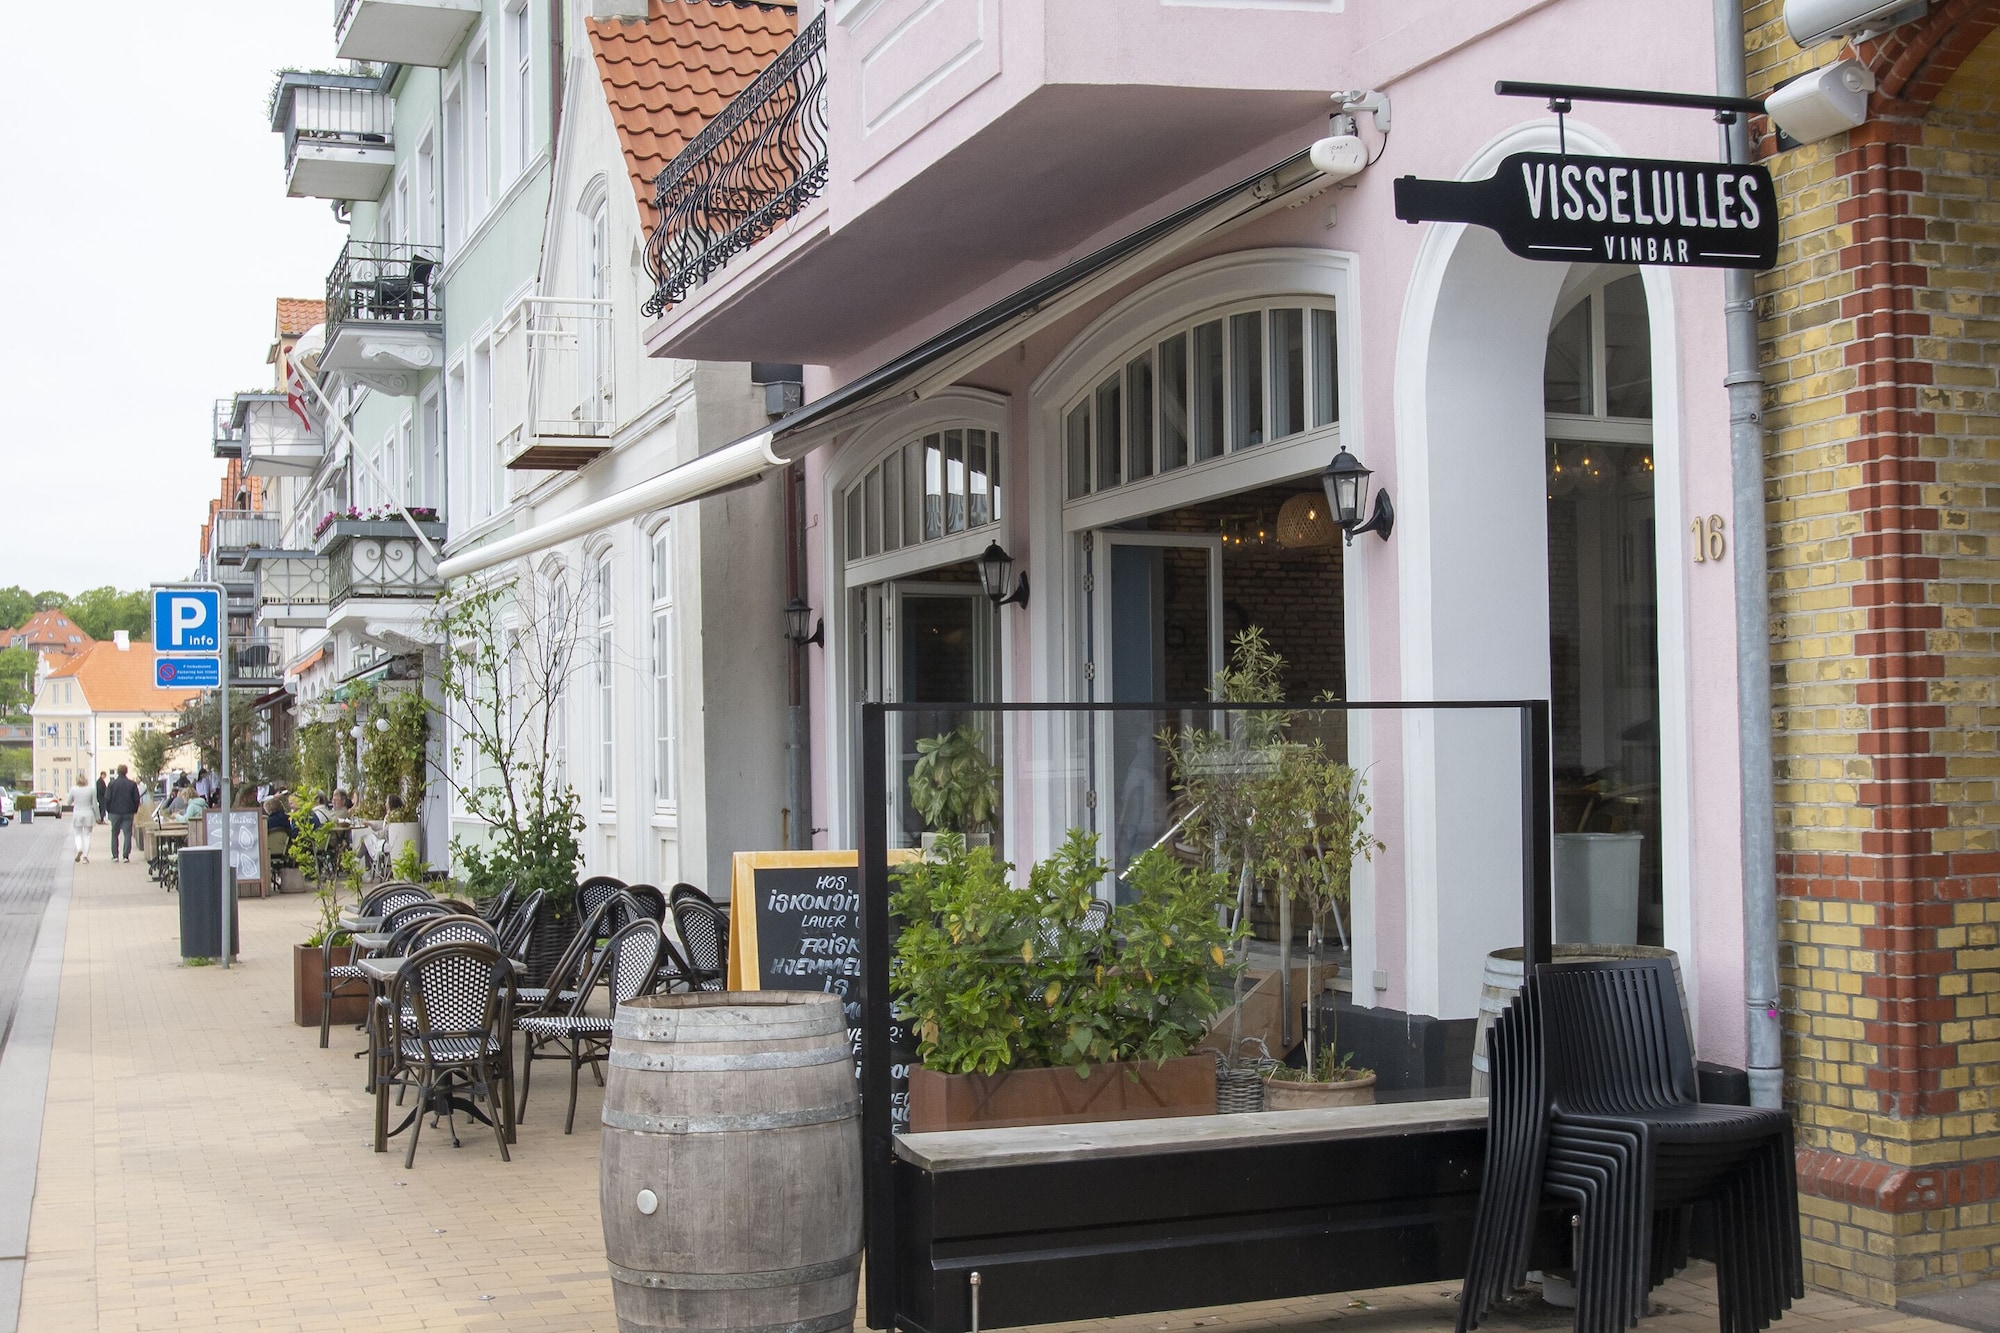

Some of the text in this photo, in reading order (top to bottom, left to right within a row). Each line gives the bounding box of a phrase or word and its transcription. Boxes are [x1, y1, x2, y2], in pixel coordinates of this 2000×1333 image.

[1521, 162, 1761, 230] VISSELULLES
[1604, 235, 1690, 263] VINBAR
[1690, 513, 1726, 564] 16
[171, 597, 207, 646] P
[767, 889, 860, 914] ISKONDIT
[816, 875, 848, 890] HOS
